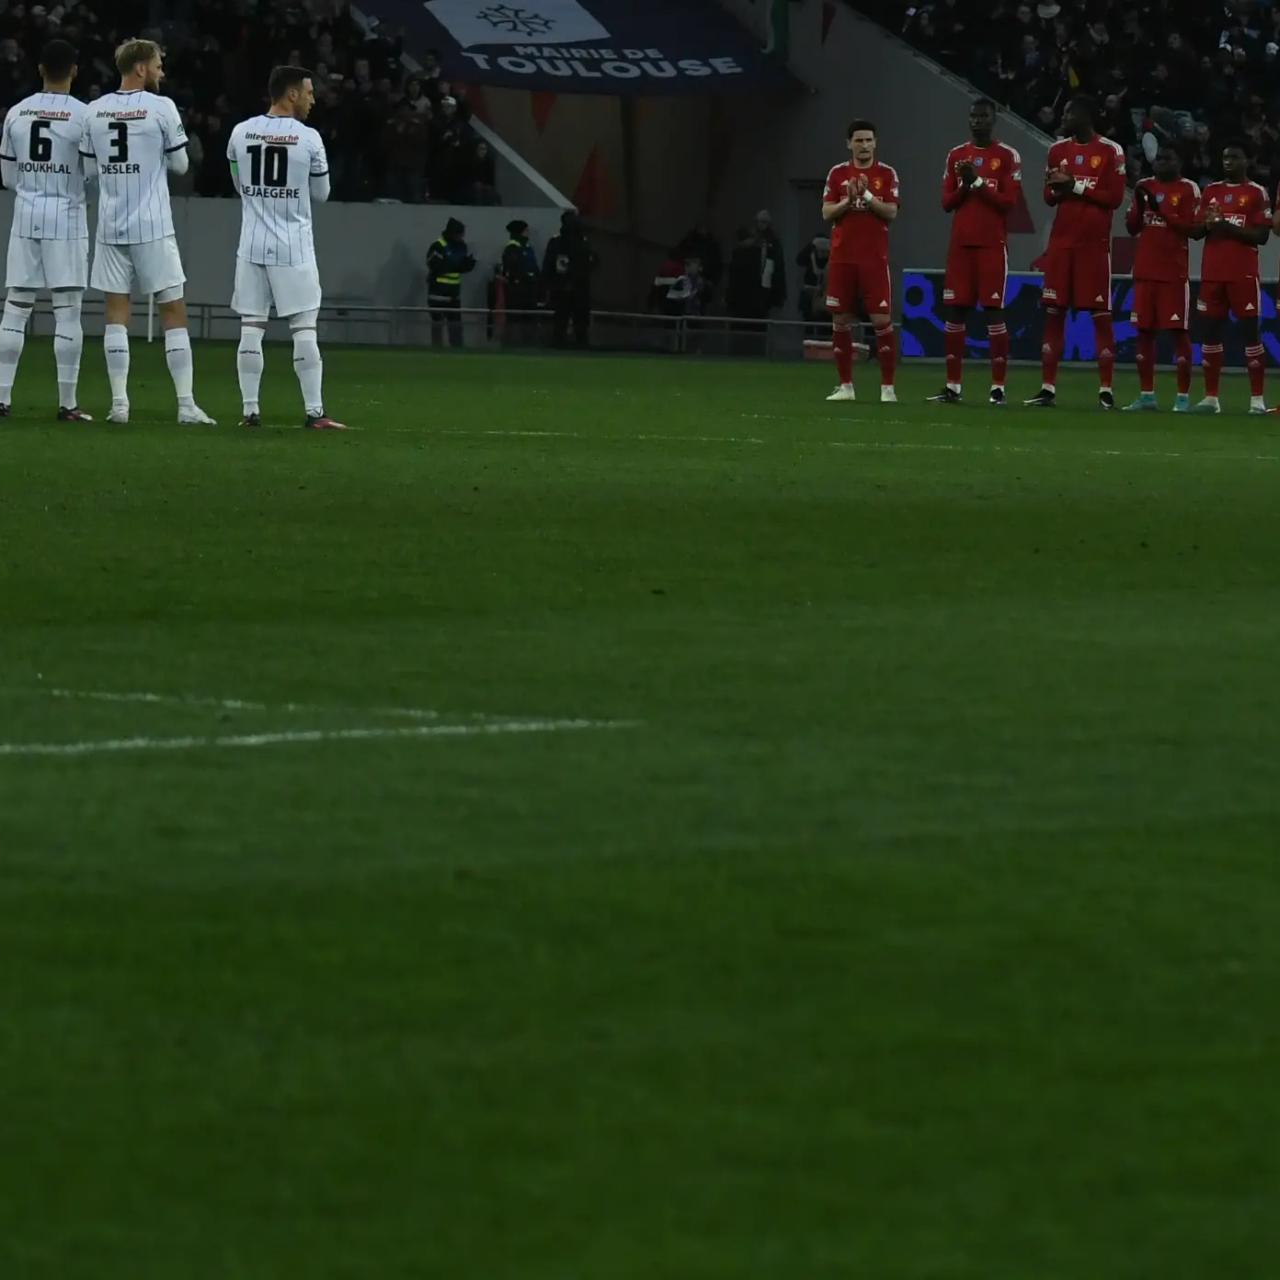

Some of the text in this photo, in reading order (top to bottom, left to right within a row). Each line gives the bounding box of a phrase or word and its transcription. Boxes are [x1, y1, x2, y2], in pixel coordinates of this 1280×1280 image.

[461, 51, 744, 79] TOULOUSE
[512, 45, 663, 60] MAIRIE DE
[29, 120, 52, 162] 6
[108, 122, 128, 163] 3
[101, 163, 141, 175] DESLER
[246, 144, 288, 187] 10
